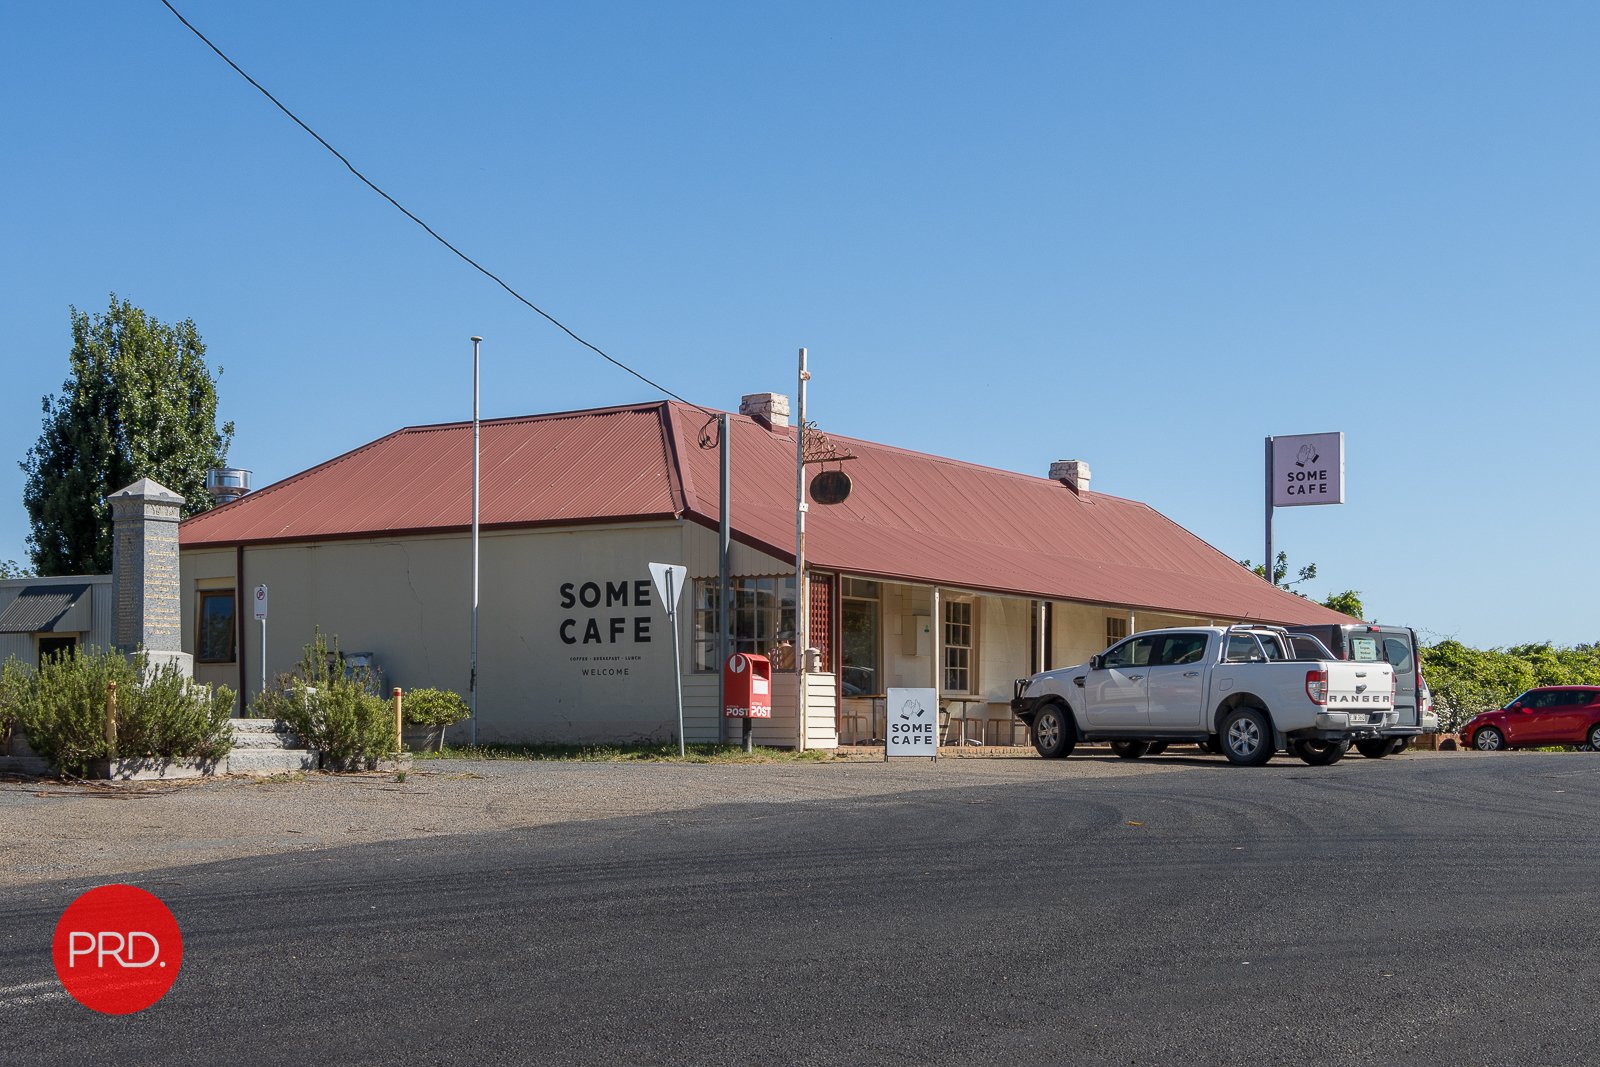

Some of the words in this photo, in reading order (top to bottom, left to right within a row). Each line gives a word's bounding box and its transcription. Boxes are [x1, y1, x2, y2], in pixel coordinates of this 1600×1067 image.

[1287, 470, 1327, 482] SOME
[1287, 483, 1327, 495] CAFE
[559, 579, 652, 609] SOME
[559, 616, 652, 645] CAFE
[581, 668, 629, 676] WELCOME
[1329, 695, 1390, 703] RANGER
[726, 707, 749, 717] POST
[751, 705, 771, 717] POST
[891, 723, 933, 733] SOME
[891, 735, 933, 745] CAFE
